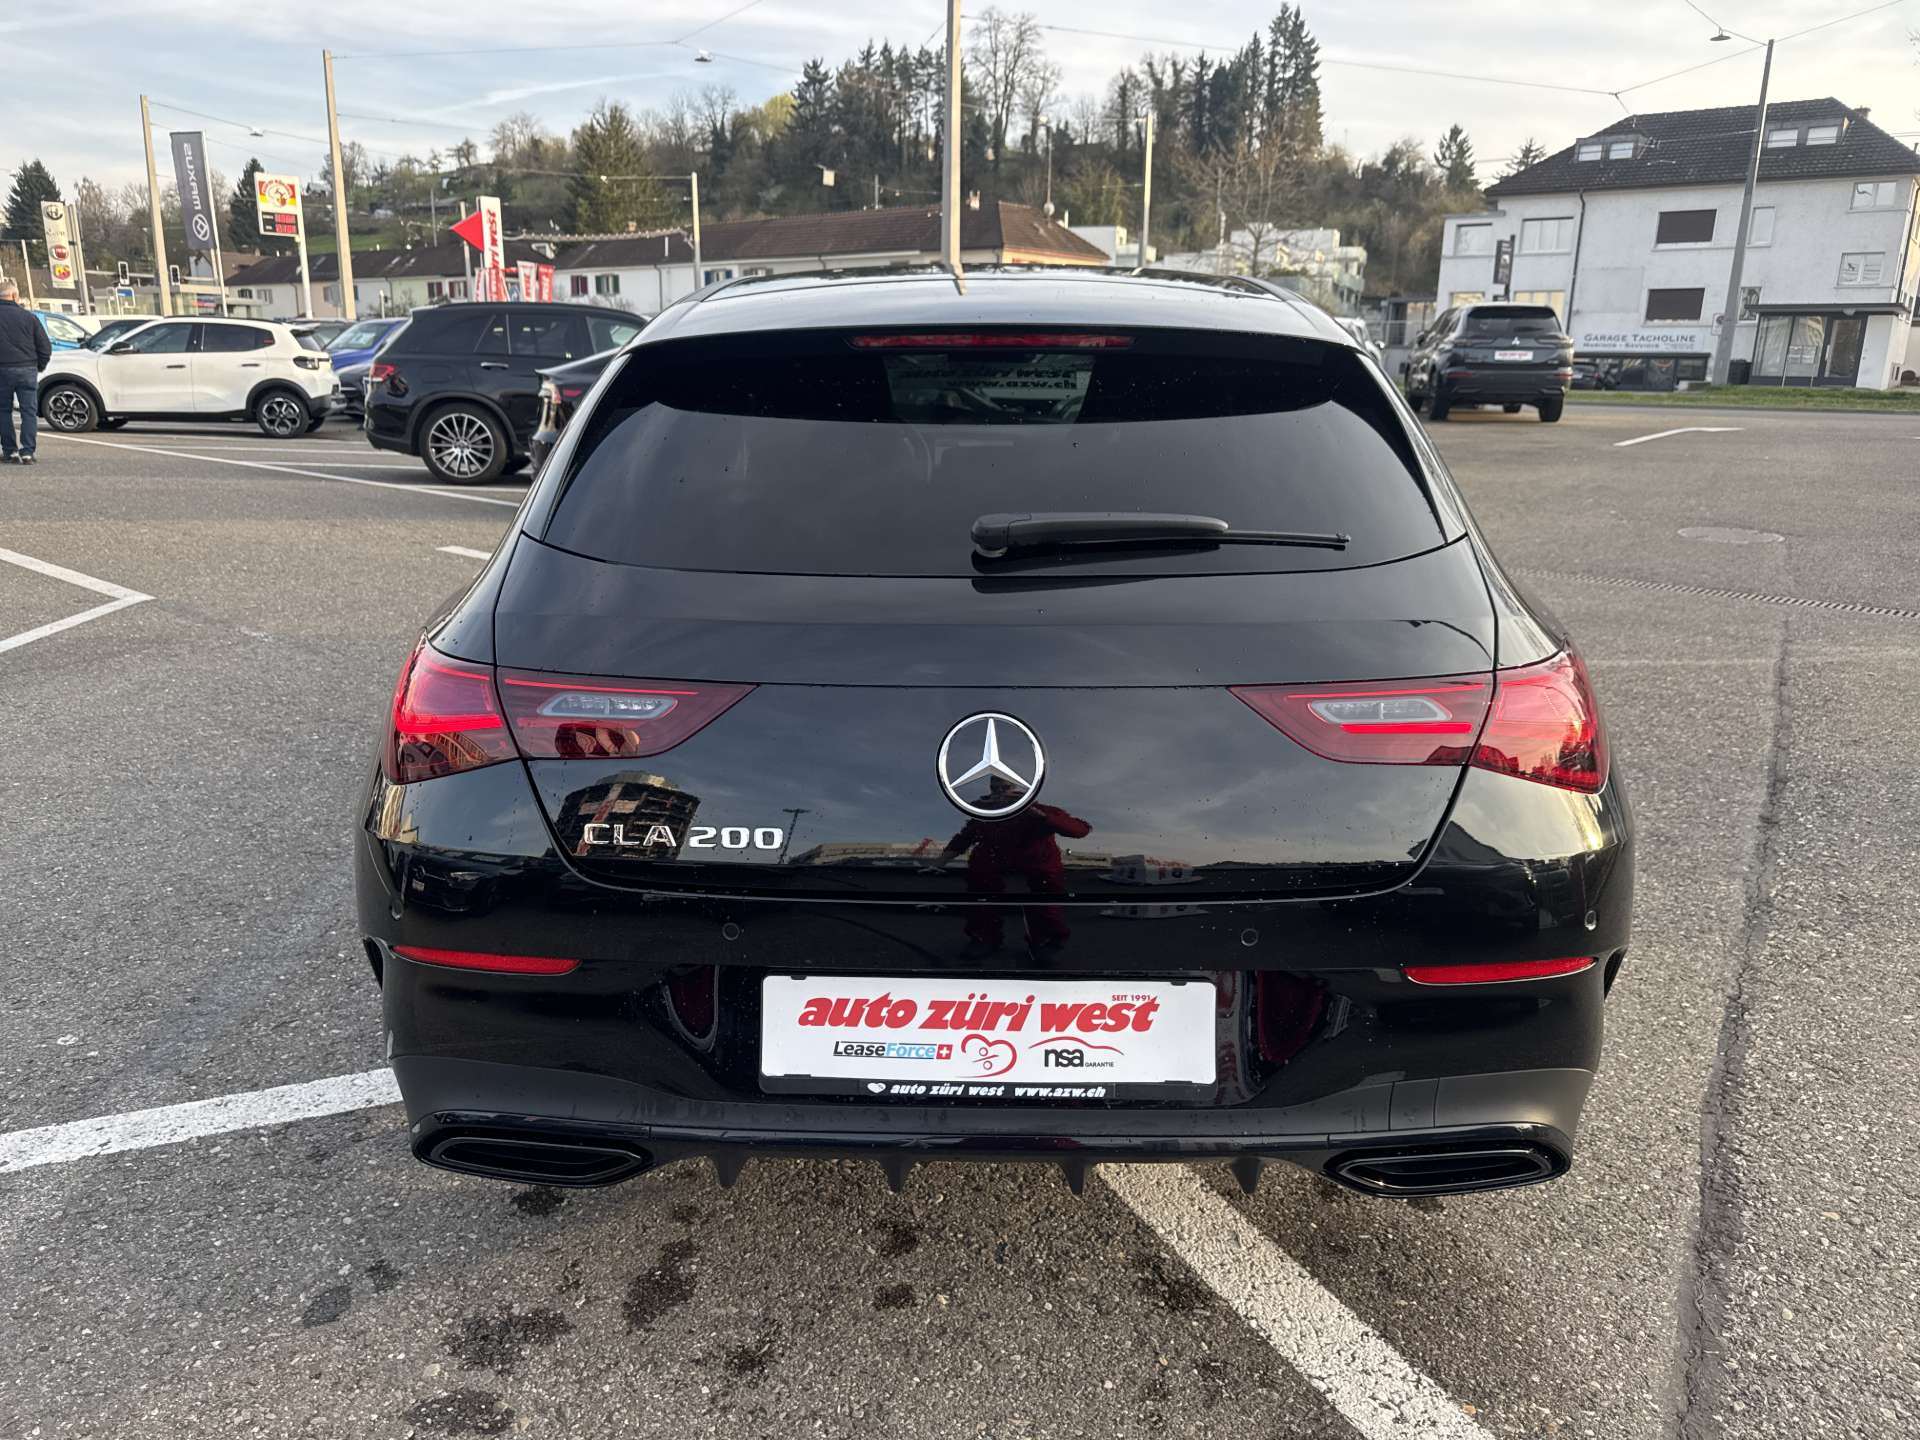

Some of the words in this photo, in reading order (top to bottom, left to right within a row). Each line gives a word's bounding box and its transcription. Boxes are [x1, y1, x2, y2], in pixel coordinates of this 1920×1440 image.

[1584, 334, 1627, 342] GARAGE
[1632, 334, 1696, 342] TACHOLINE
[584, 823, 677, 847] CLA
[688, 826, 784, 850] 200
[798, 992, 918, 1029] auto
[918, 993, 1036, 1031] züri
[1041, 996, 1160, 1032] west
[833, 1041, 936, 1058] LeaseForce
[1044, 1048, 1084, 1068] nsa
[890, 1084, 926, 1095] auto
[929, 1083, 964, 1096] züri
[968, 1085, 1004, 1096] west
[1014, 1086, 1106, 1098] www.azw.ch
